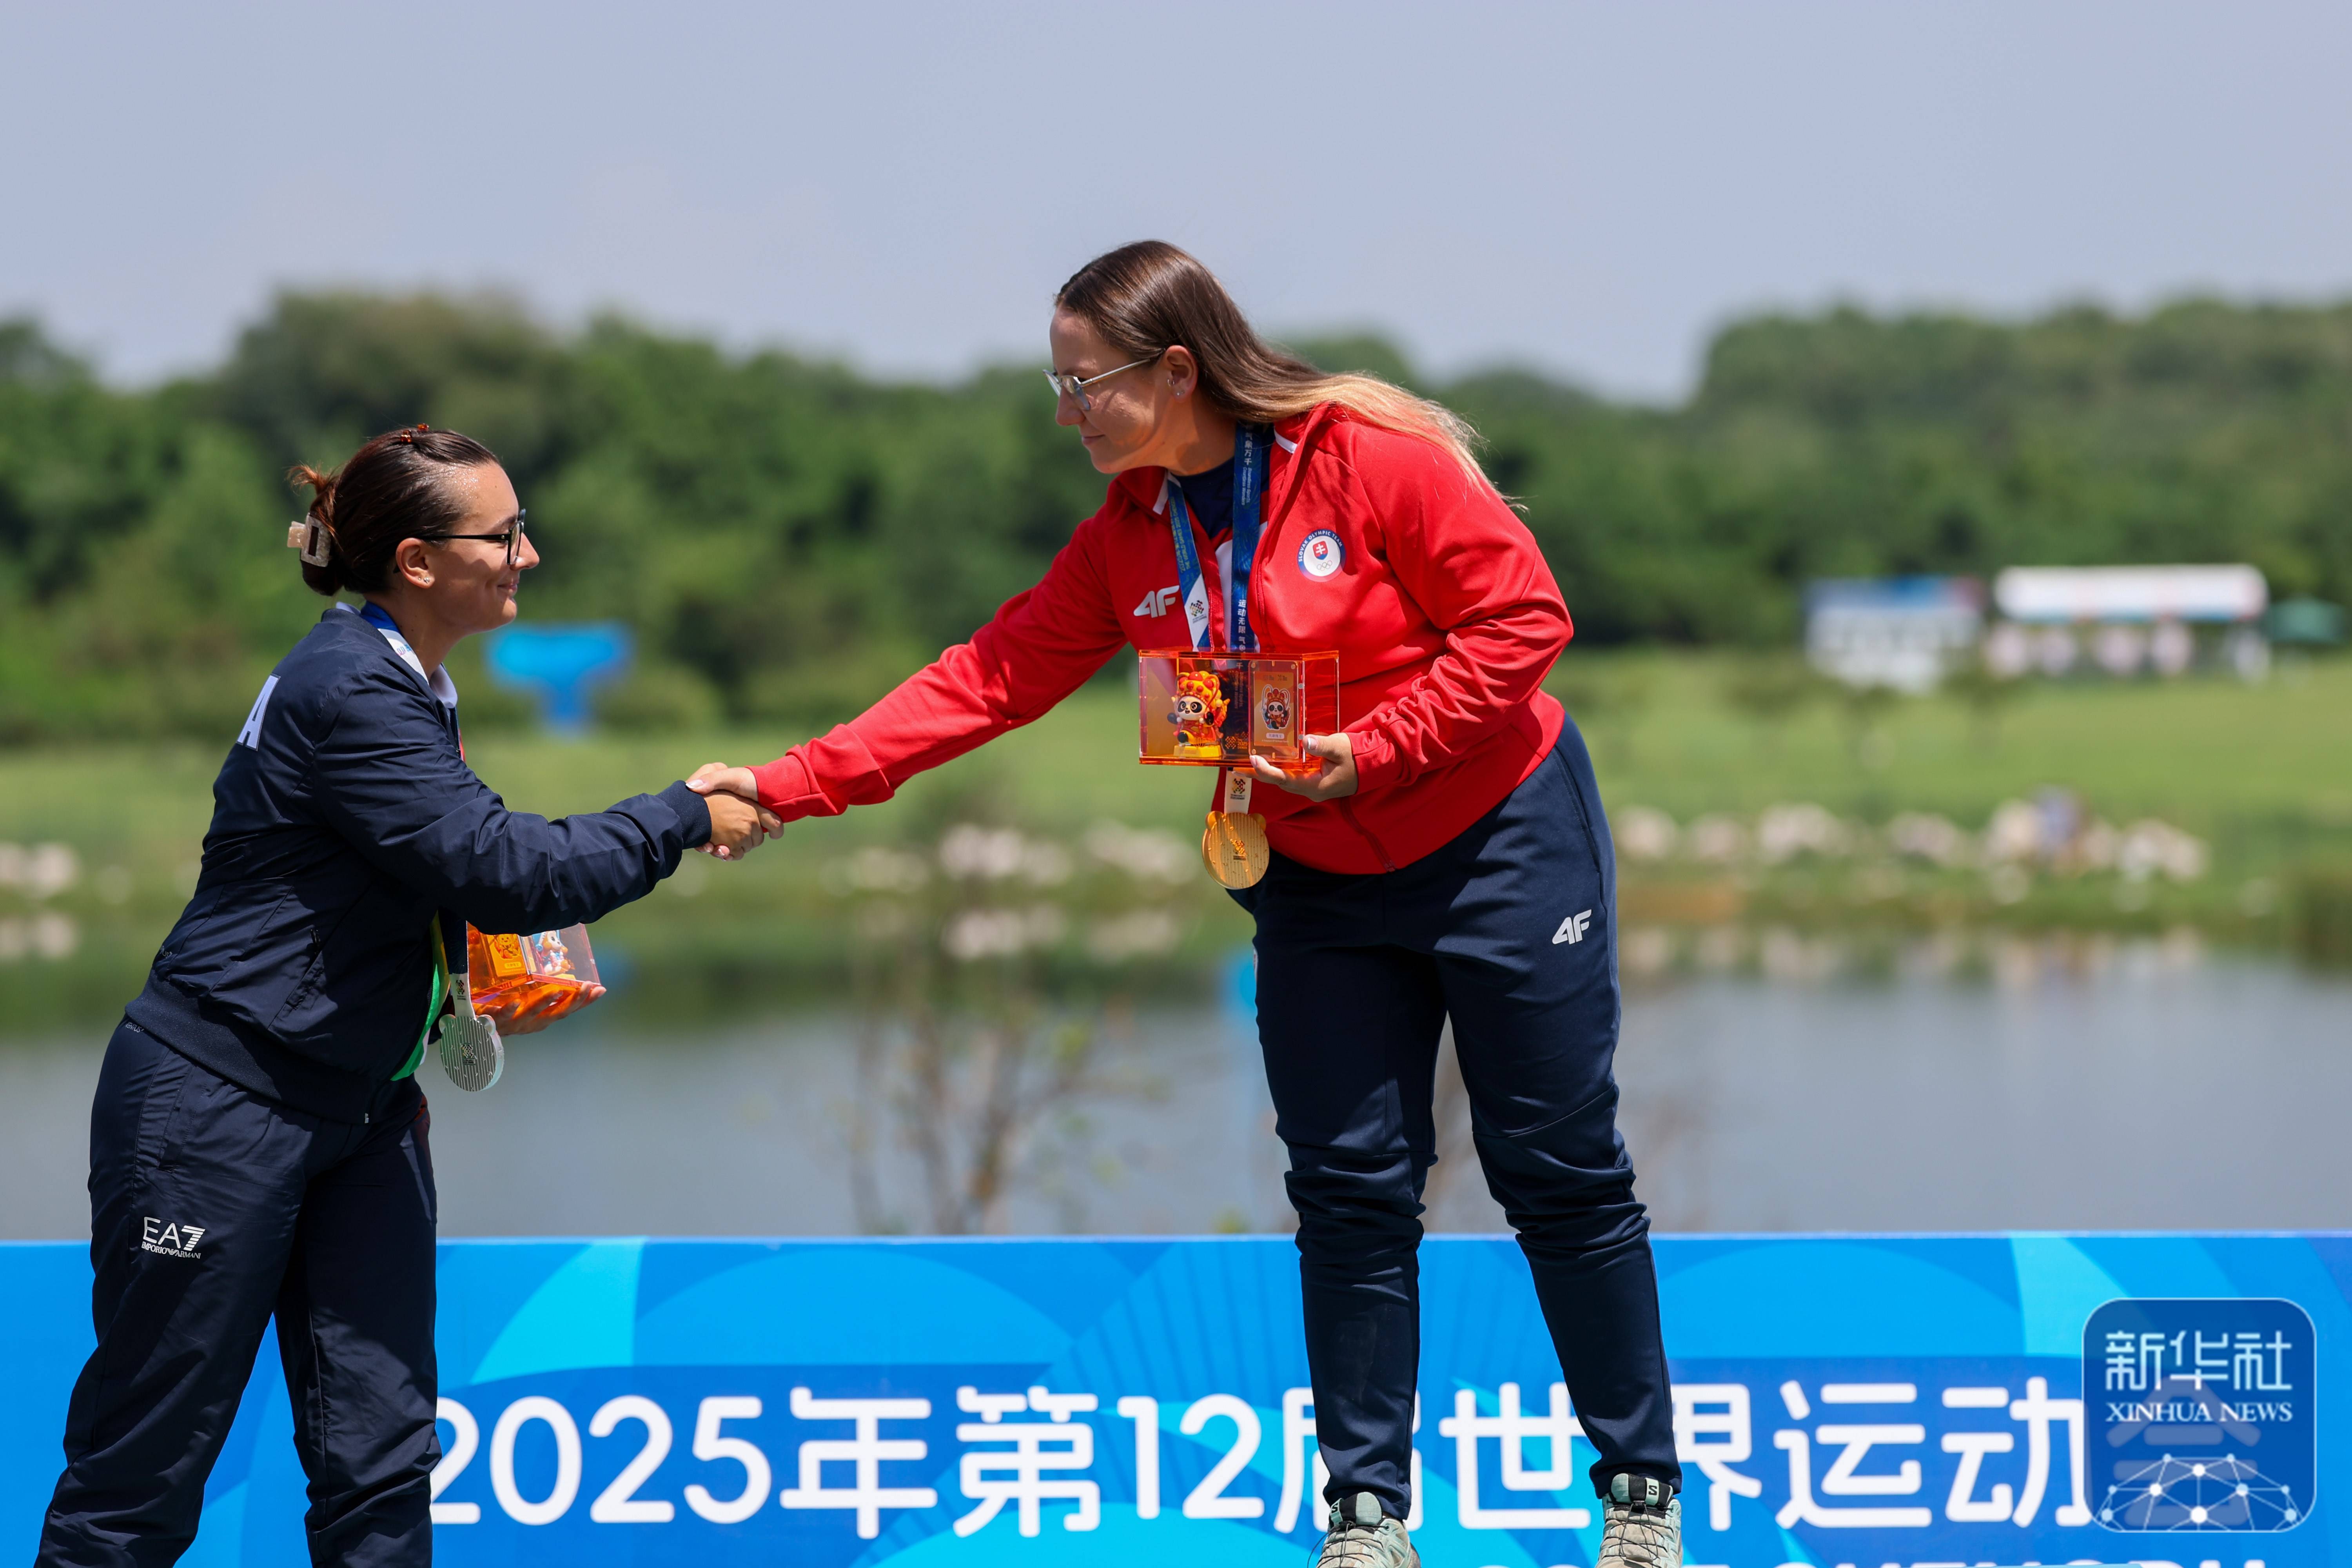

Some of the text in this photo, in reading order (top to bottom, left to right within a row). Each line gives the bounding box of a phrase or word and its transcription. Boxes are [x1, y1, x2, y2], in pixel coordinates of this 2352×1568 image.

[1298, 530, 1342, 562] SLOVAK OLYMPIC TEAM
[1133, 585, 1180, 618] 4F
[1238, 599, 1247, 633] 运动无限
[1552, 909, 1592, 945] 4F
[142, 1241, 201, 1259] EMPORIO ARMANI
[143, 1217, 205, 1251] EA7
